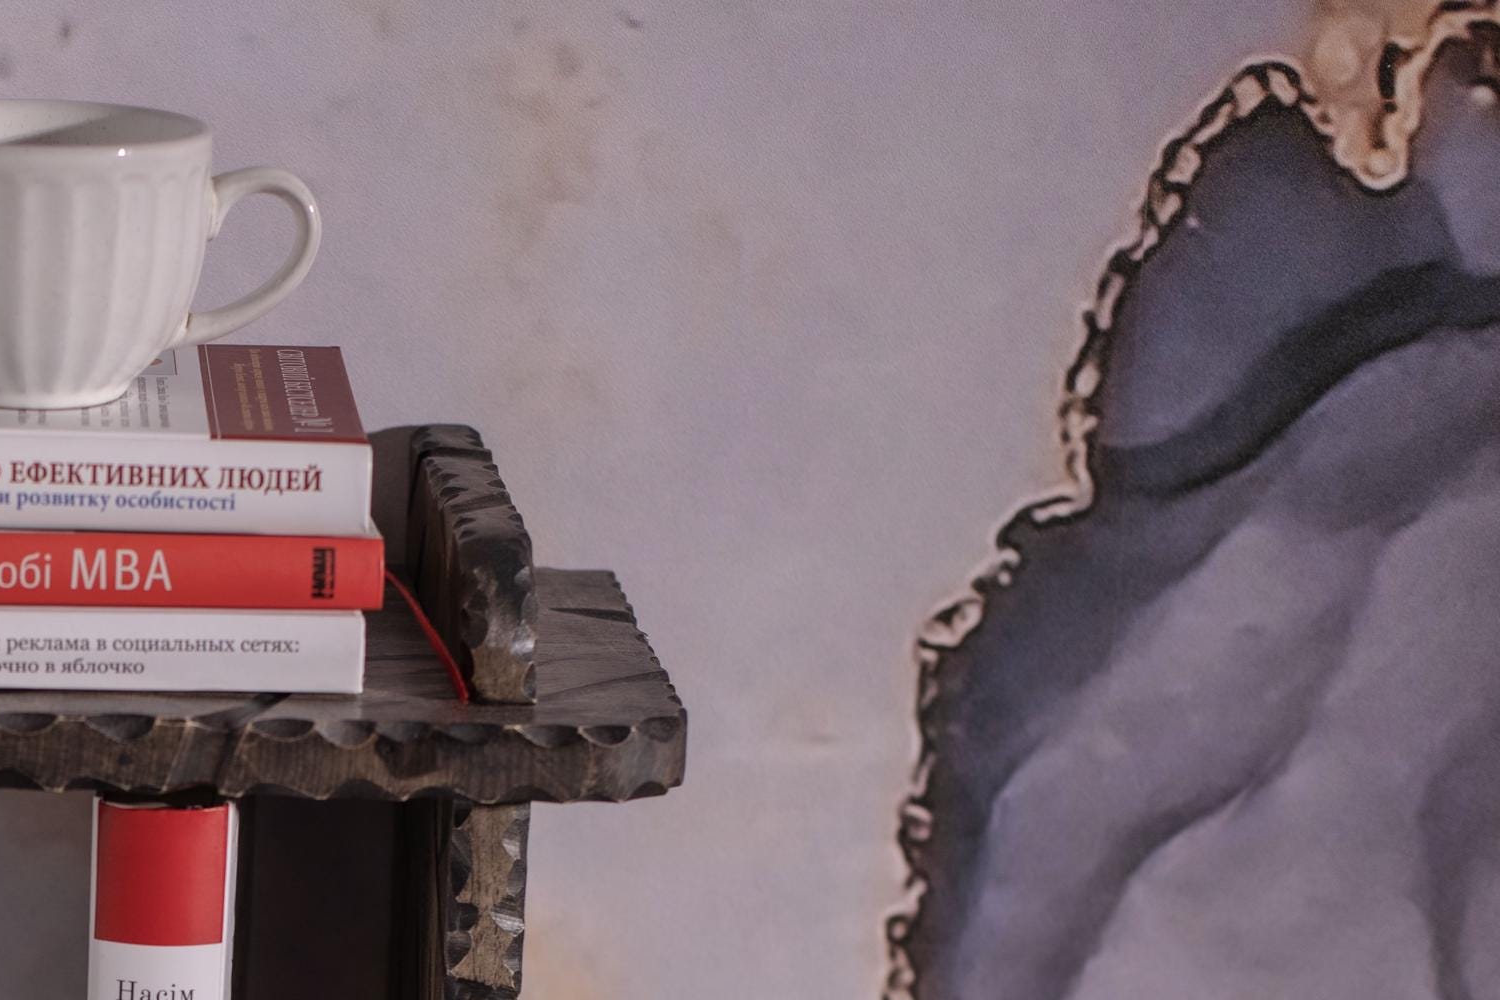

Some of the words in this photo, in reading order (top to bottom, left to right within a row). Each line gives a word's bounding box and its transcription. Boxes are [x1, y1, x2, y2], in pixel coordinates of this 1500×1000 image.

[9, 460, 211, 489] ЕФЕКТИВНИХ
[217, 464, 323, 494] ЛЮДЕЙ
[16, 490, 109, 514] розвитку
[115, 491, 236, 512] особистості
[6, 638, 90, 655] реклама
[96, 641, 107, 653] в
[112, 638, 235, 657] социальных
[240, 640, 300, 654] сетях:
[44, 661, 55, 674] в
[61, 658, 145, 675] яблочко
